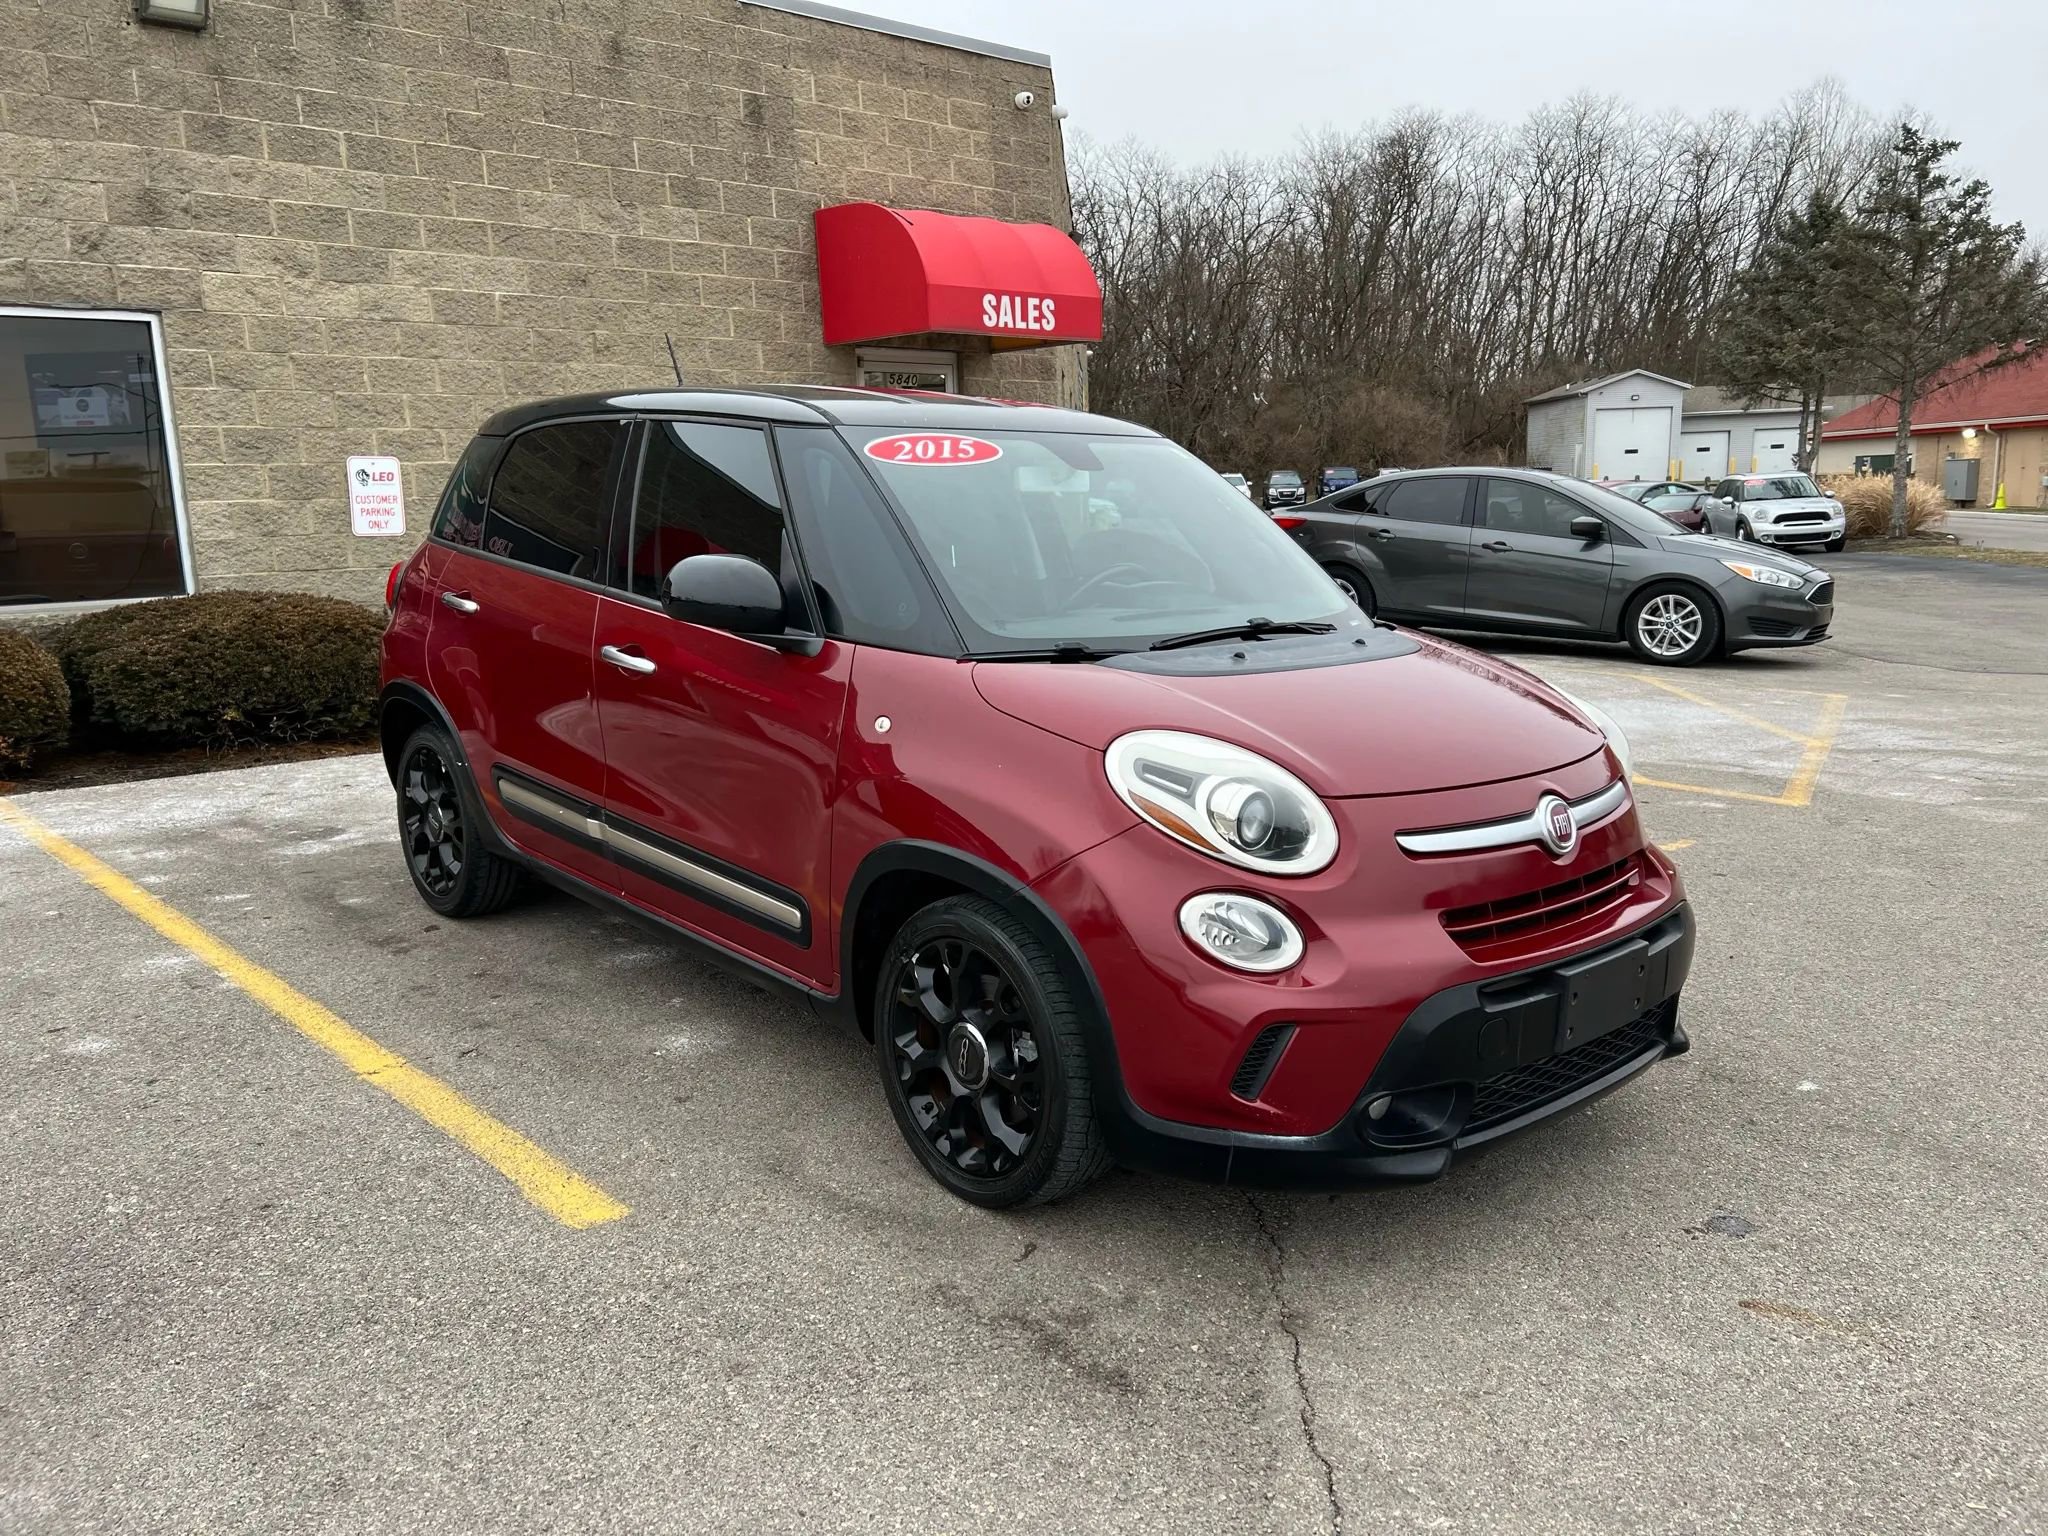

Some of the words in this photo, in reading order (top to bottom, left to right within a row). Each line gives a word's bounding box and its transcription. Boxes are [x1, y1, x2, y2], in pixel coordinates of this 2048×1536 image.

[982, 293, 1056, 331] SALES
[889, 373, 917, 386] 5840
[893, 439, 976, 461] 2015
[372, 471, 395, 482] LEO
[355, 495, 398, 505] CUSTOMER
[360, 507, 396, 517] PARKING
[368, 520, 389, 529] ONLY
[1553, 813, 1571, 836] FIAT
